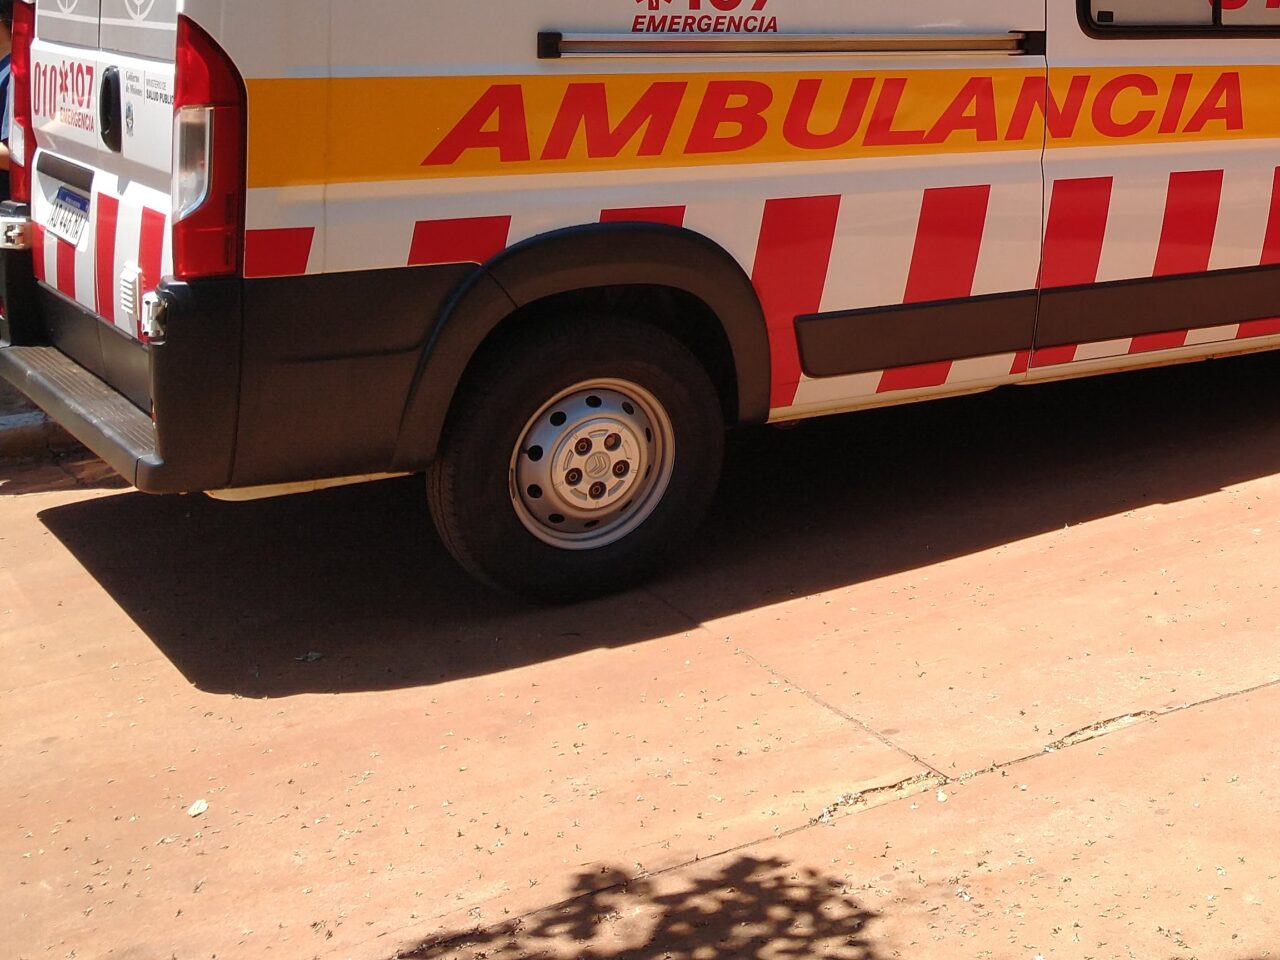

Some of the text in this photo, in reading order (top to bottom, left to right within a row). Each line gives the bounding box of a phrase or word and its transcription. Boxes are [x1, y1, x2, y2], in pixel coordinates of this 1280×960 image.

[631, 14, 779, 33] EMERGENCIA
[33, 61, 94, 120] 010 107
[419, 71, 1244, 166] AMBULANCIA
